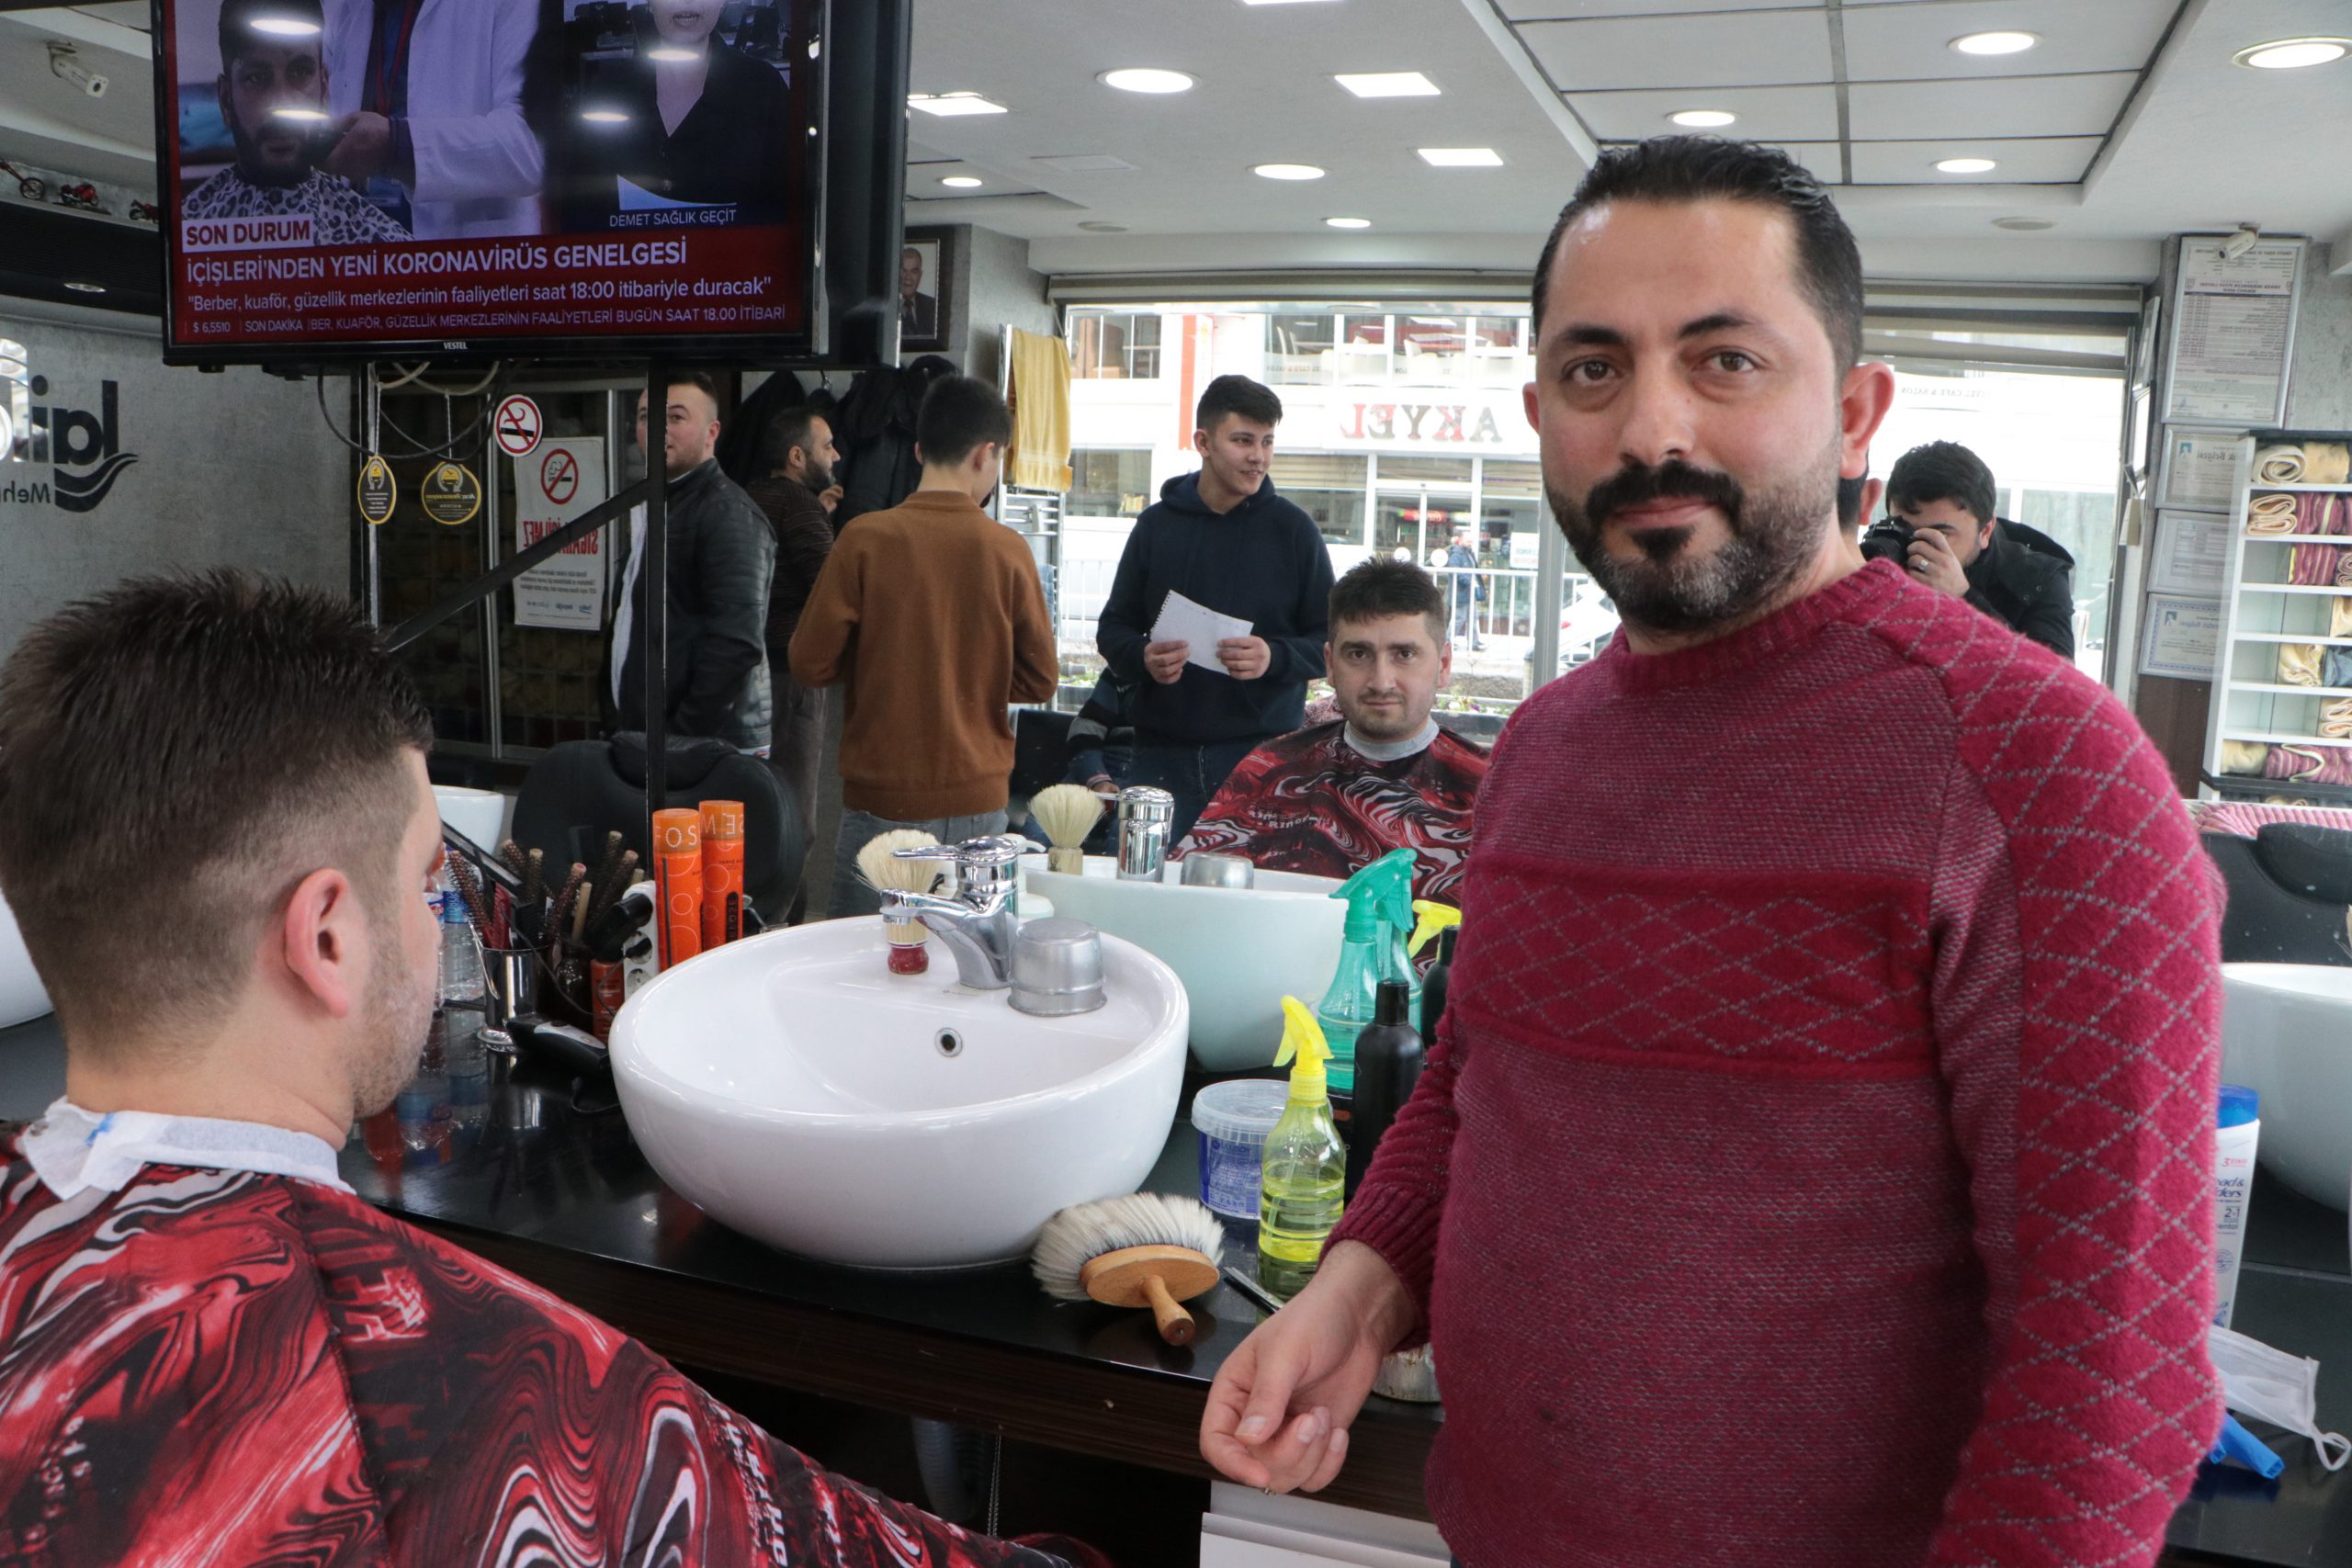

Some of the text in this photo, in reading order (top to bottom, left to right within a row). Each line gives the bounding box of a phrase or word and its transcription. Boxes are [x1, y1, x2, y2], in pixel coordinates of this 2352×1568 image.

[609, 208, 737, 227] DEMET SAĞLIK GEÇİT
[186, 220, 311, 246] SON DURUM
[187, 235, 686, 287] İÇİŞLERİ'NDEN YENİ KORONAVİRÜS GENELGESİ
[244, 291, 291, 310] kuaför,
[294, 290, 346, 311] güzellik
[350, 287, 447, 307] merkezlerinin
[451, 283, 529, 307] faaliyetleri
[533, 286, 566, 301] saat
[570, 280, 615, 299] 18:00
[619, 278, 689, 301] itibariyle
[693, 276, 772, 297] duracak"
[245, 321, 266, 333] SON
[266, 318, 303, 332] DAKİKA
[336, 315, 383, 330] KUAFÖR,
[385, 313, 437, 328] GÜZELLİK
[440, 310, 529, 327] MERKEZLERİNİN
[532, 308, 613, 324] FAALİYETLERİ
[616, 307, 662, 322] BUGÜN
[666, 308, 700, 321] SAAT
[704, 308, 736, 321] 18.00
[443, 342, 468, 350] VESTEL
